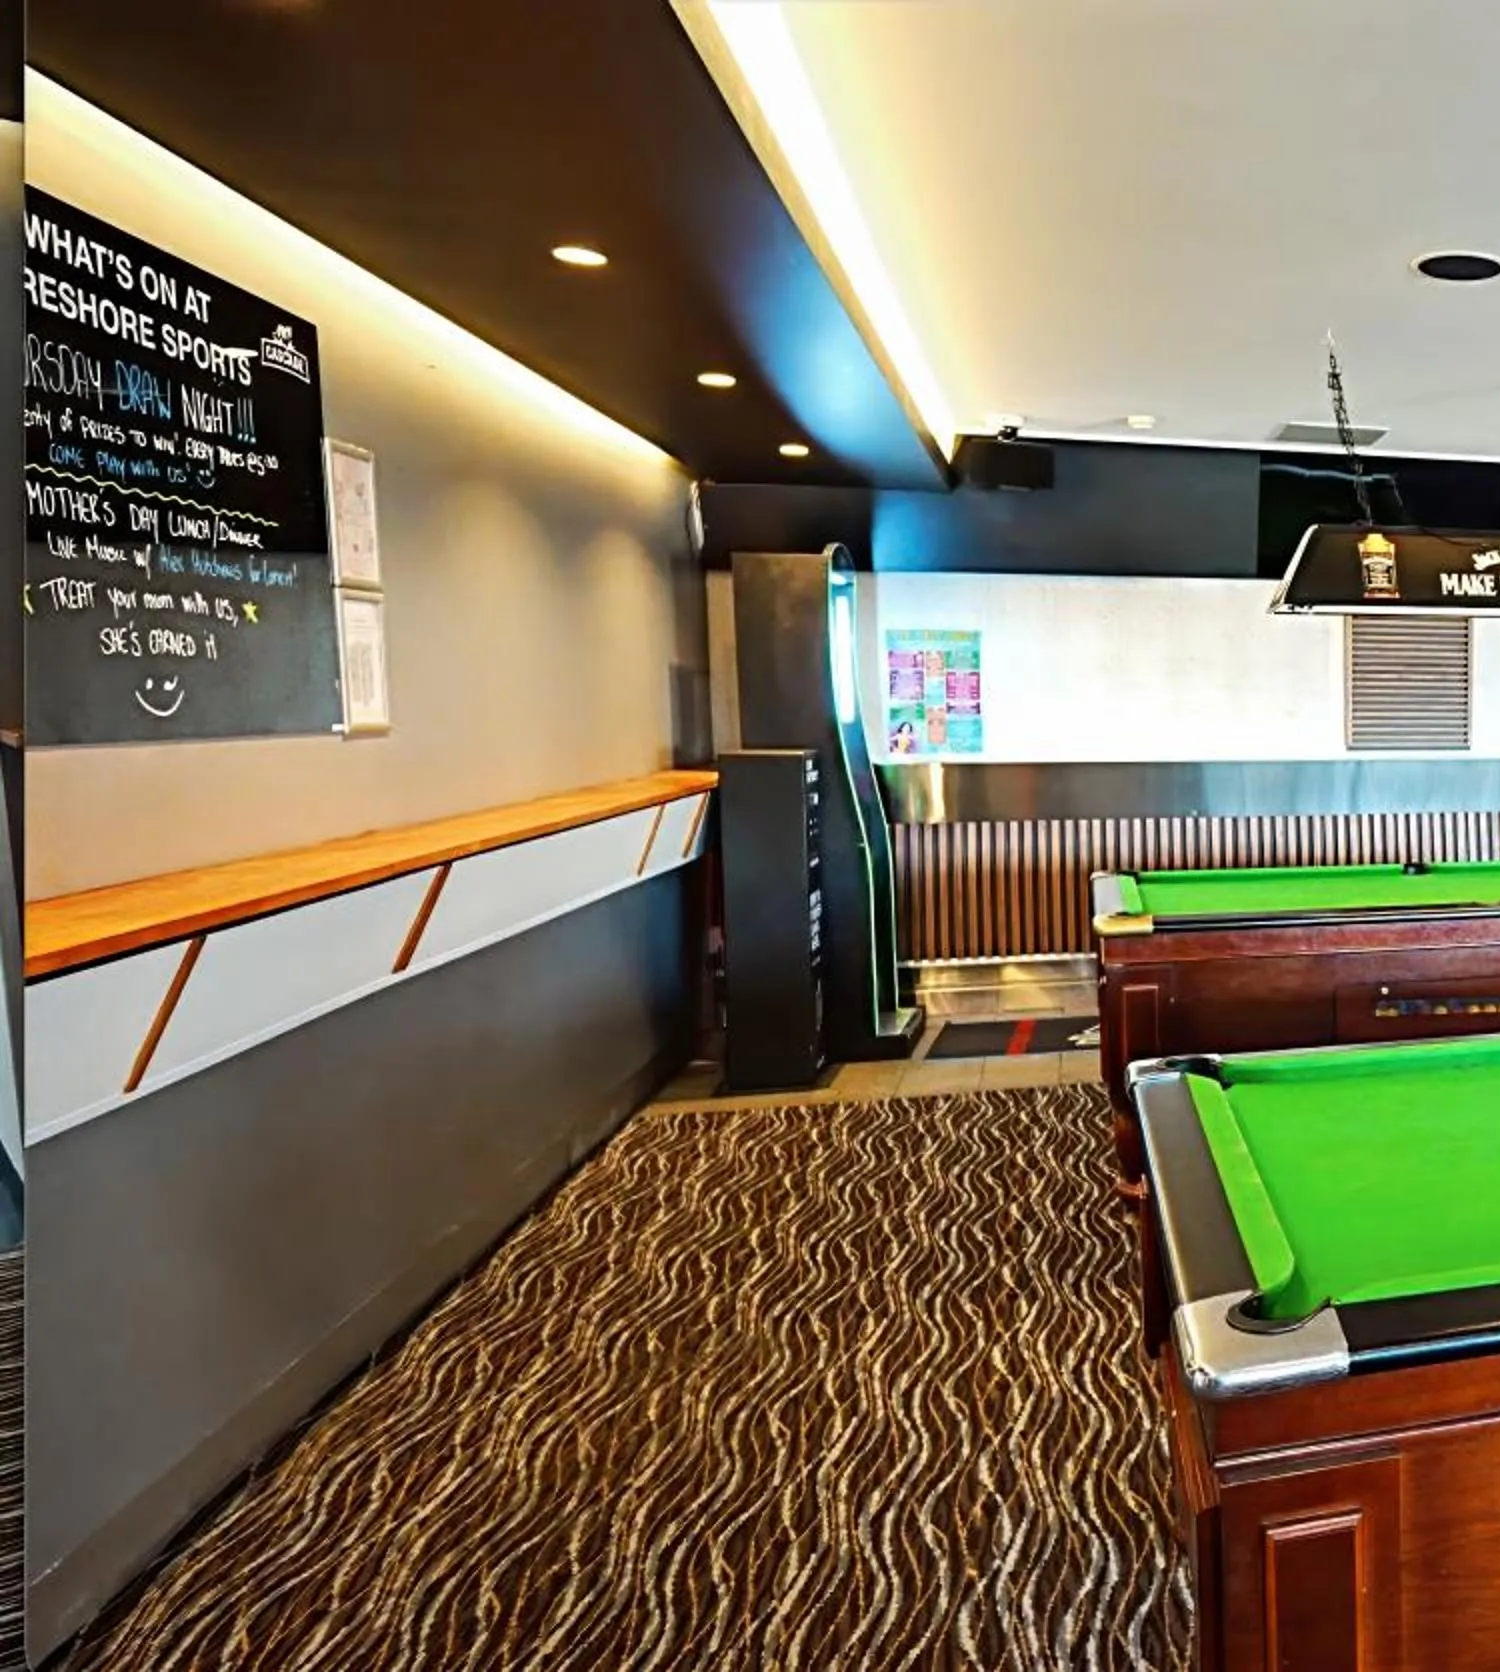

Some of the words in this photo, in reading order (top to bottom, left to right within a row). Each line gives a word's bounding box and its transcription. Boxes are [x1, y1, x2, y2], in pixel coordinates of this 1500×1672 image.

[24, 209, 134, 290] WHAT'S
[140, 265, 178, 310] ON
[184, 285, 212, 324] AT
[24, 266, 156, 350] RESHORE
[161, 323, 252, 386] SPORTS
[115, 360, 172, 420] DRAW
[128, 429, 147, 447] TO
[49, 443, 85, 469] COME
[96, 451, 126, 484] PLAY
[25, 480, 116, 526] MOTHER'S
[129, 503, 158, 544] DAY
[47, 531, 79, 560] LIVE
[39, 577, 96, 611] TREAT
[1440, 573, 1497, 597] MAKE
[99, 620, 143, 657] SHE'S
[149, 628, 197, 657] EARNED
